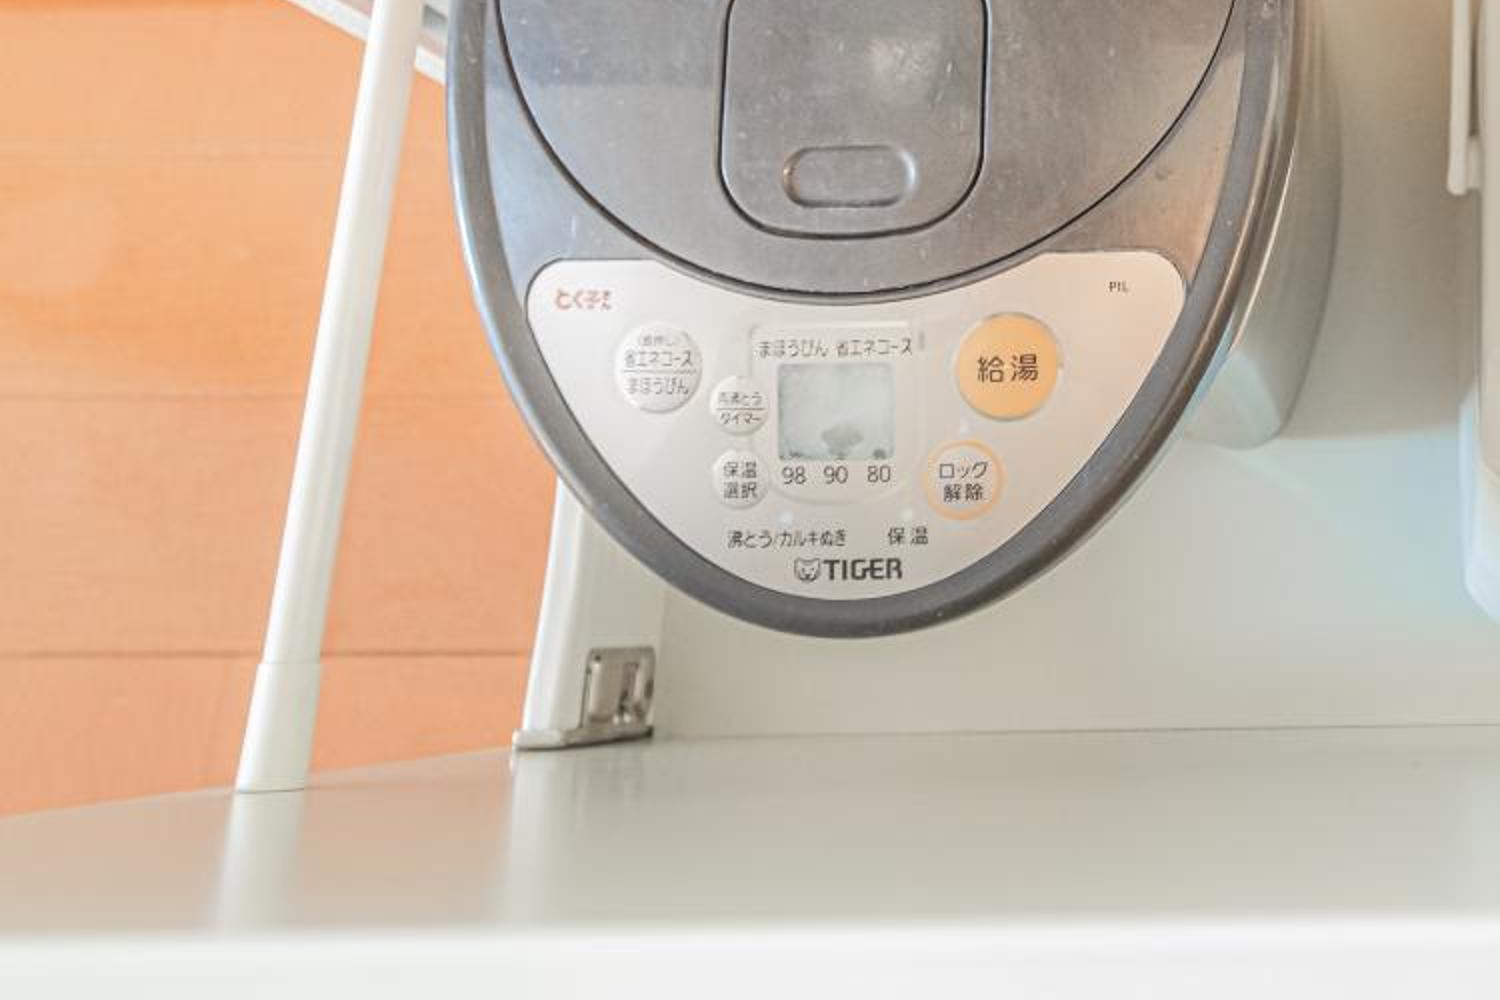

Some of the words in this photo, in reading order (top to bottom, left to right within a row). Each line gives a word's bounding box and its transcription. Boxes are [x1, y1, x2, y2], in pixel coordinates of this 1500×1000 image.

[756, 338, 828, 359] まほうびん
[837, 337, 913, 357] 省エネコース
[624, 350, 694, 368] 省エネコース
[976, 353, 1040, 384] 給湯
[626, 377, 690, 396] まほうびん
[719, 411, 762, 426] タイマー
[723, 461, 758, 479] 保温
[782, 465, 806, 485] 98
[823, 465, 849, 484] 90
[867, 465, 891, 484] 80
[938, 461, 988, 480] ロック
[723, 481, 758, 499] 選択
[943, 483, 984, 502] 解除
[887, 527, 928, 546] 保温
[823, 557, 903, 581] TIGER
